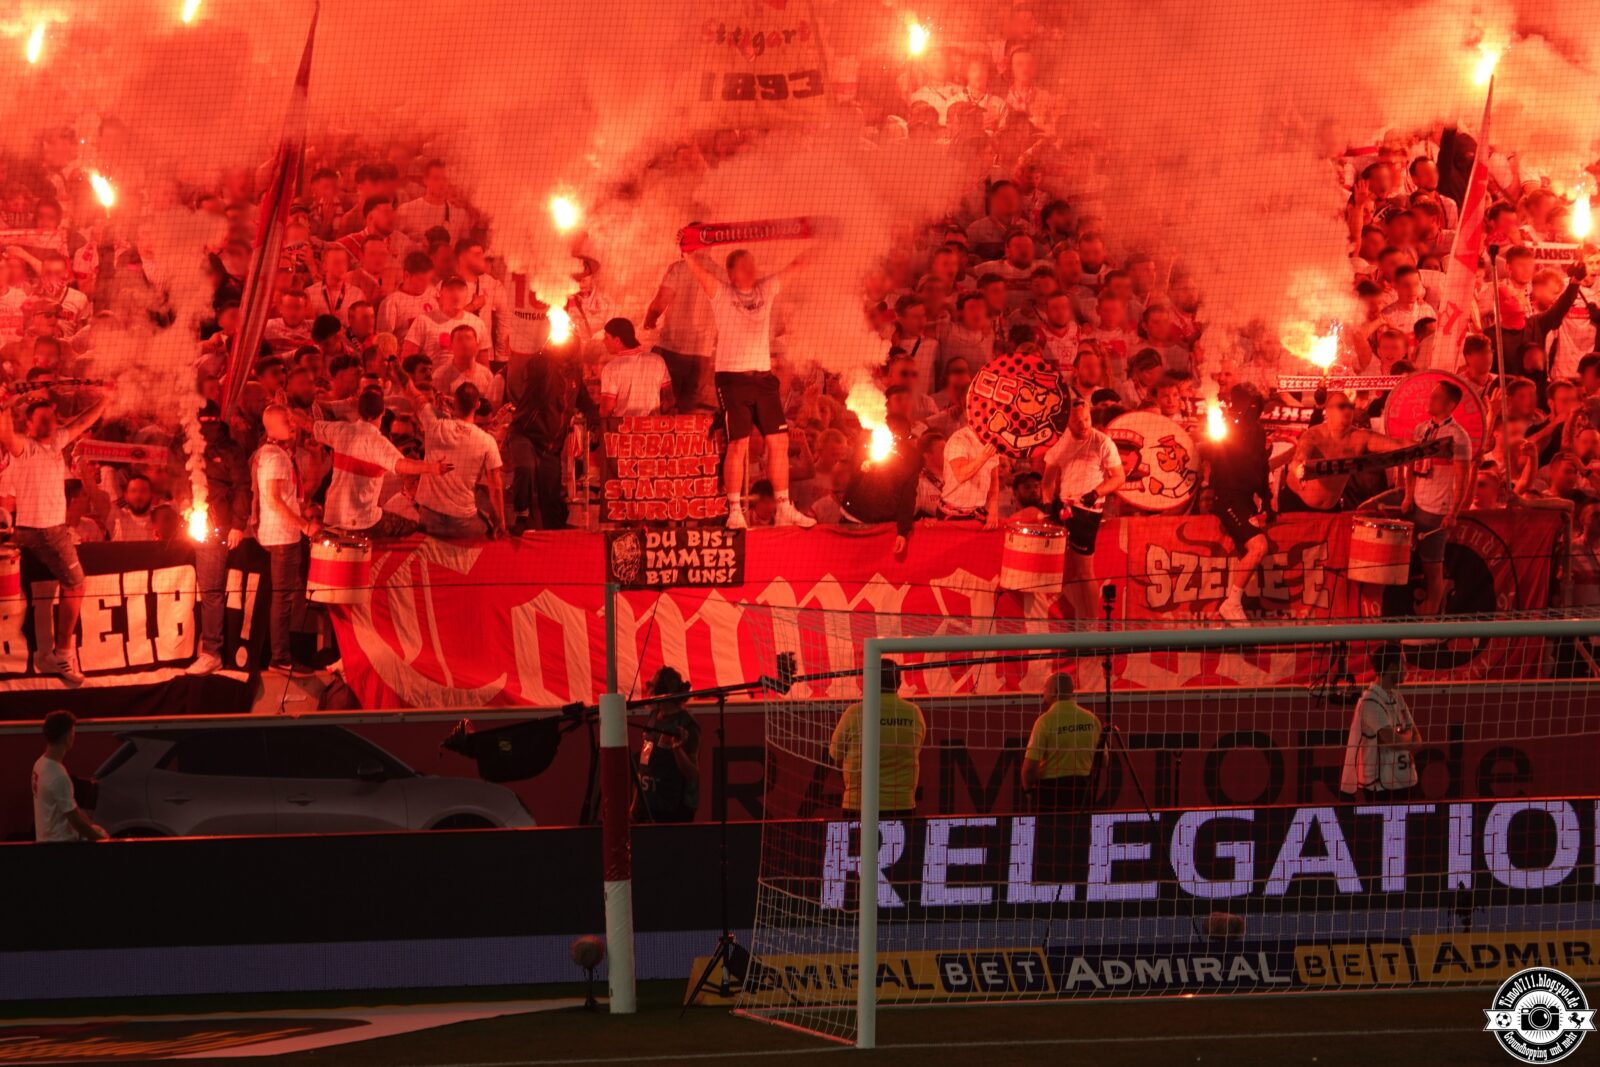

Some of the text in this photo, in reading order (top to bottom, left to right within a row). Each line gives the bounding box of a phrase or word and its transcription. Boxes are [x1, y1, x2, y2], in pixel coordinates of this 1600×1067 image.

[700, 70, 825, 100] 1893
[618, 414, 714, 433] JEDER
[617, 455, 720, 478] KEHRT
[607, 496, 729, 521] ZURÜCK
[646, 529, 735, 548] DU BIST
[646, 549, 736, 568] IMMER
[646, 568, 737, 585] BEI UNS!
[1302, 541, 1329, 609] E
[880, 718, 914, 727] CURITY
[819, 799, 1600, 909] RELEGATIO
[944, 960, 1037, 986] BET
[1064, 951, 1292, 990] ADMIRAL
[1303, 952, 1400, 977] BET
[1432, 940, 1600, 974] ADMIR
